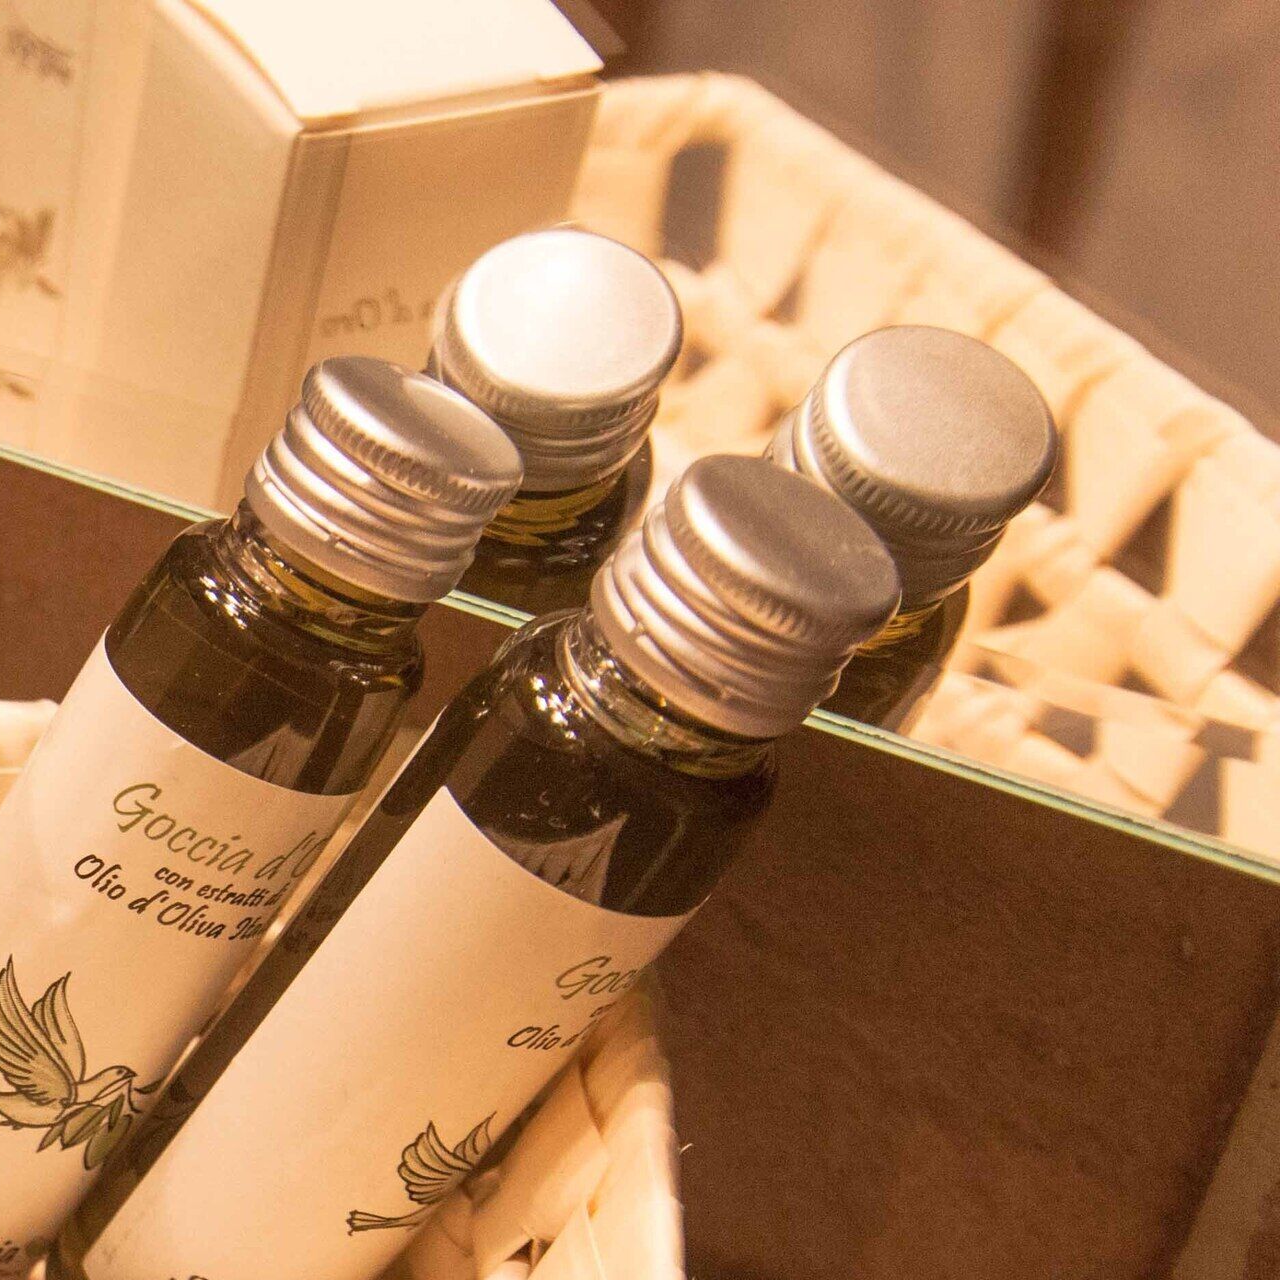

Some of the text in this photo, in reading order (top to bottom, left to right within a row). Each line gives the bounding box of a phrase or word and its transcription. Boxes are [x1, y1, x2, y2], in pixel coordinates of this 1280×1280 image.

[112, 782, 254, 876] Goccia
[73, 853, 127, 902] Olio
[127, 889, 227, 940] d'Oliva
[154, 866, 192, 891] con
[196, 884, 270, 908] estratti
[506, 1024, 562, 1051] Olio
